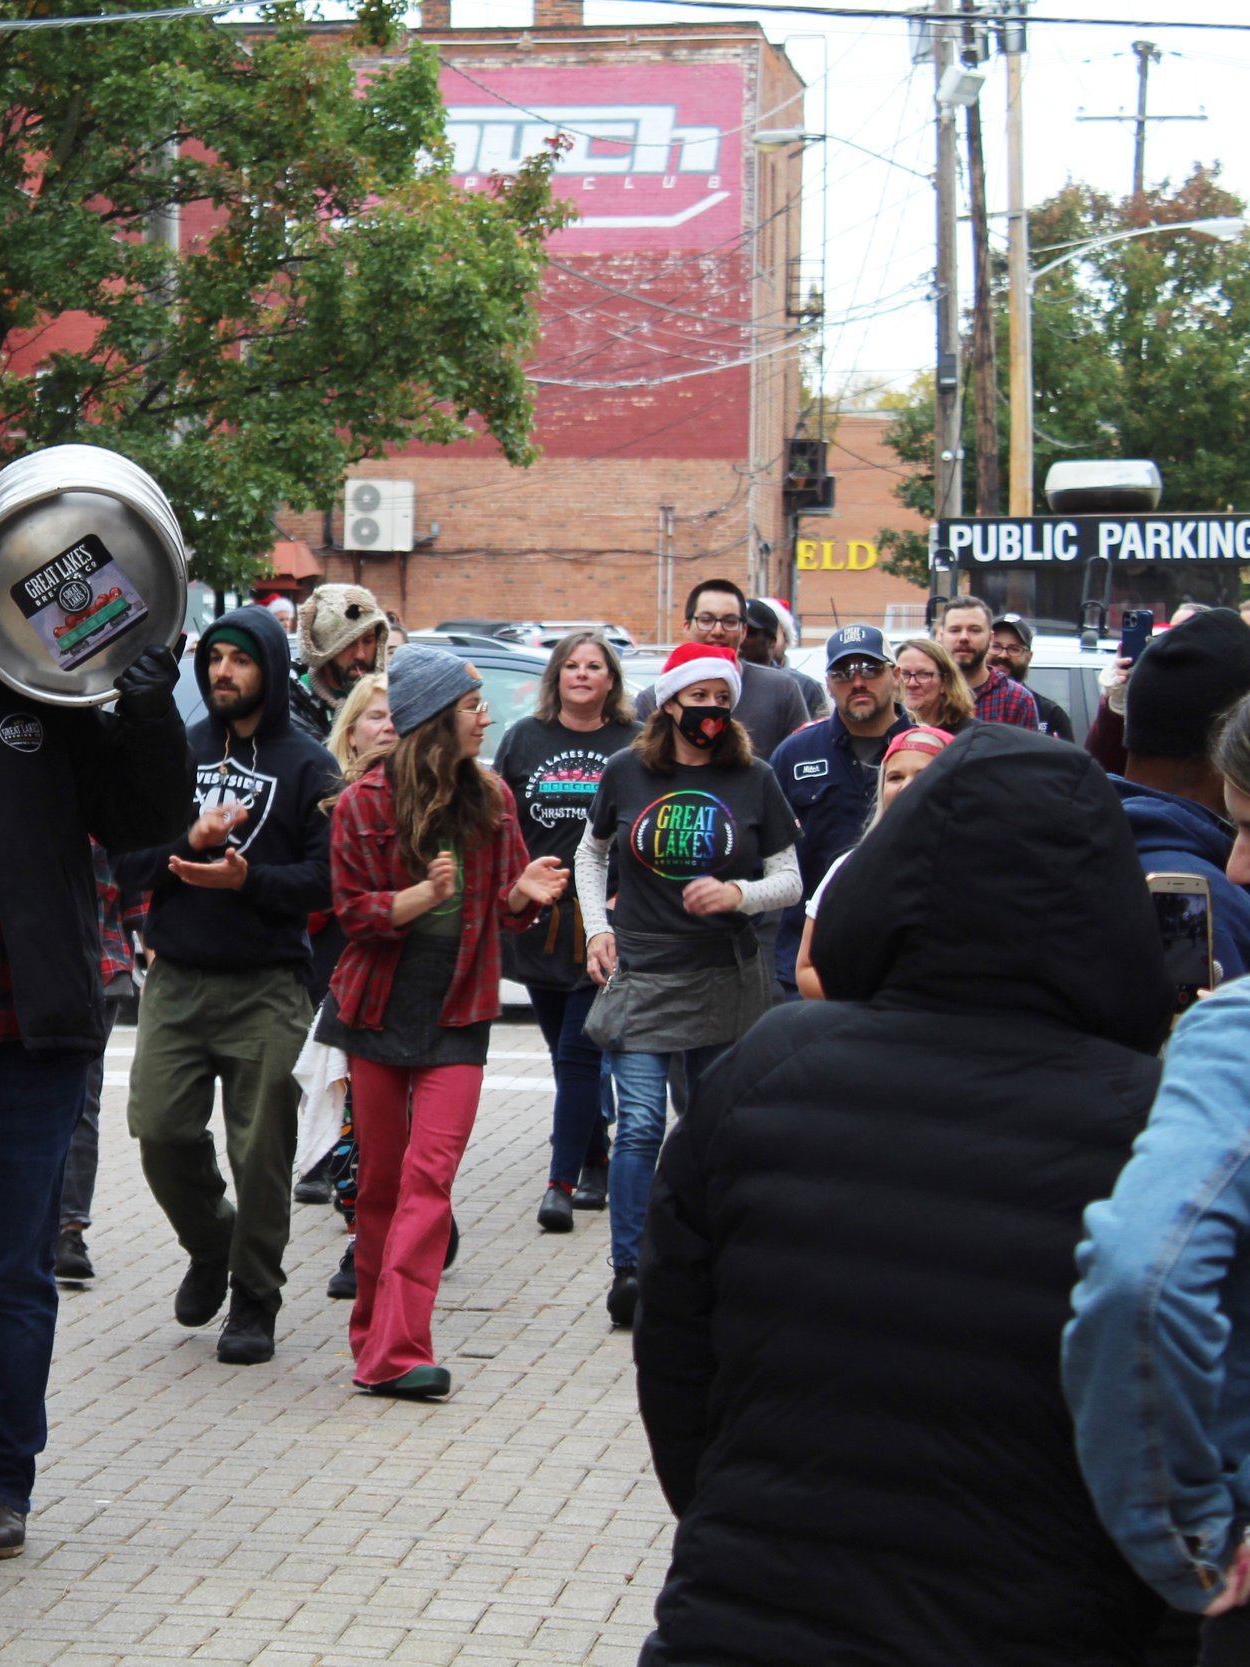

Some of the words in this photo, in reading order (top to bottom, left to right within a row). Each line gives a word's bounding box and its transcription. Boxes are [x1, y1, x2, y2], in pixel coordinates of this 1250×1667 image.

[797, 541, 879, 571] ELD
[949, 521, 1079, 563] PUBLIC
[1099, 520, 1250, 560] PARKING
[24, 565, 60, 599] GREAT
[54, 543, 93, 579] LAKES
[525, 765, 545, 799] GREAT
[545, 750, 584, 767] LAKES
[657, 804, 718, 831] GREAT
[654, 830, 716, 858] LAKES
